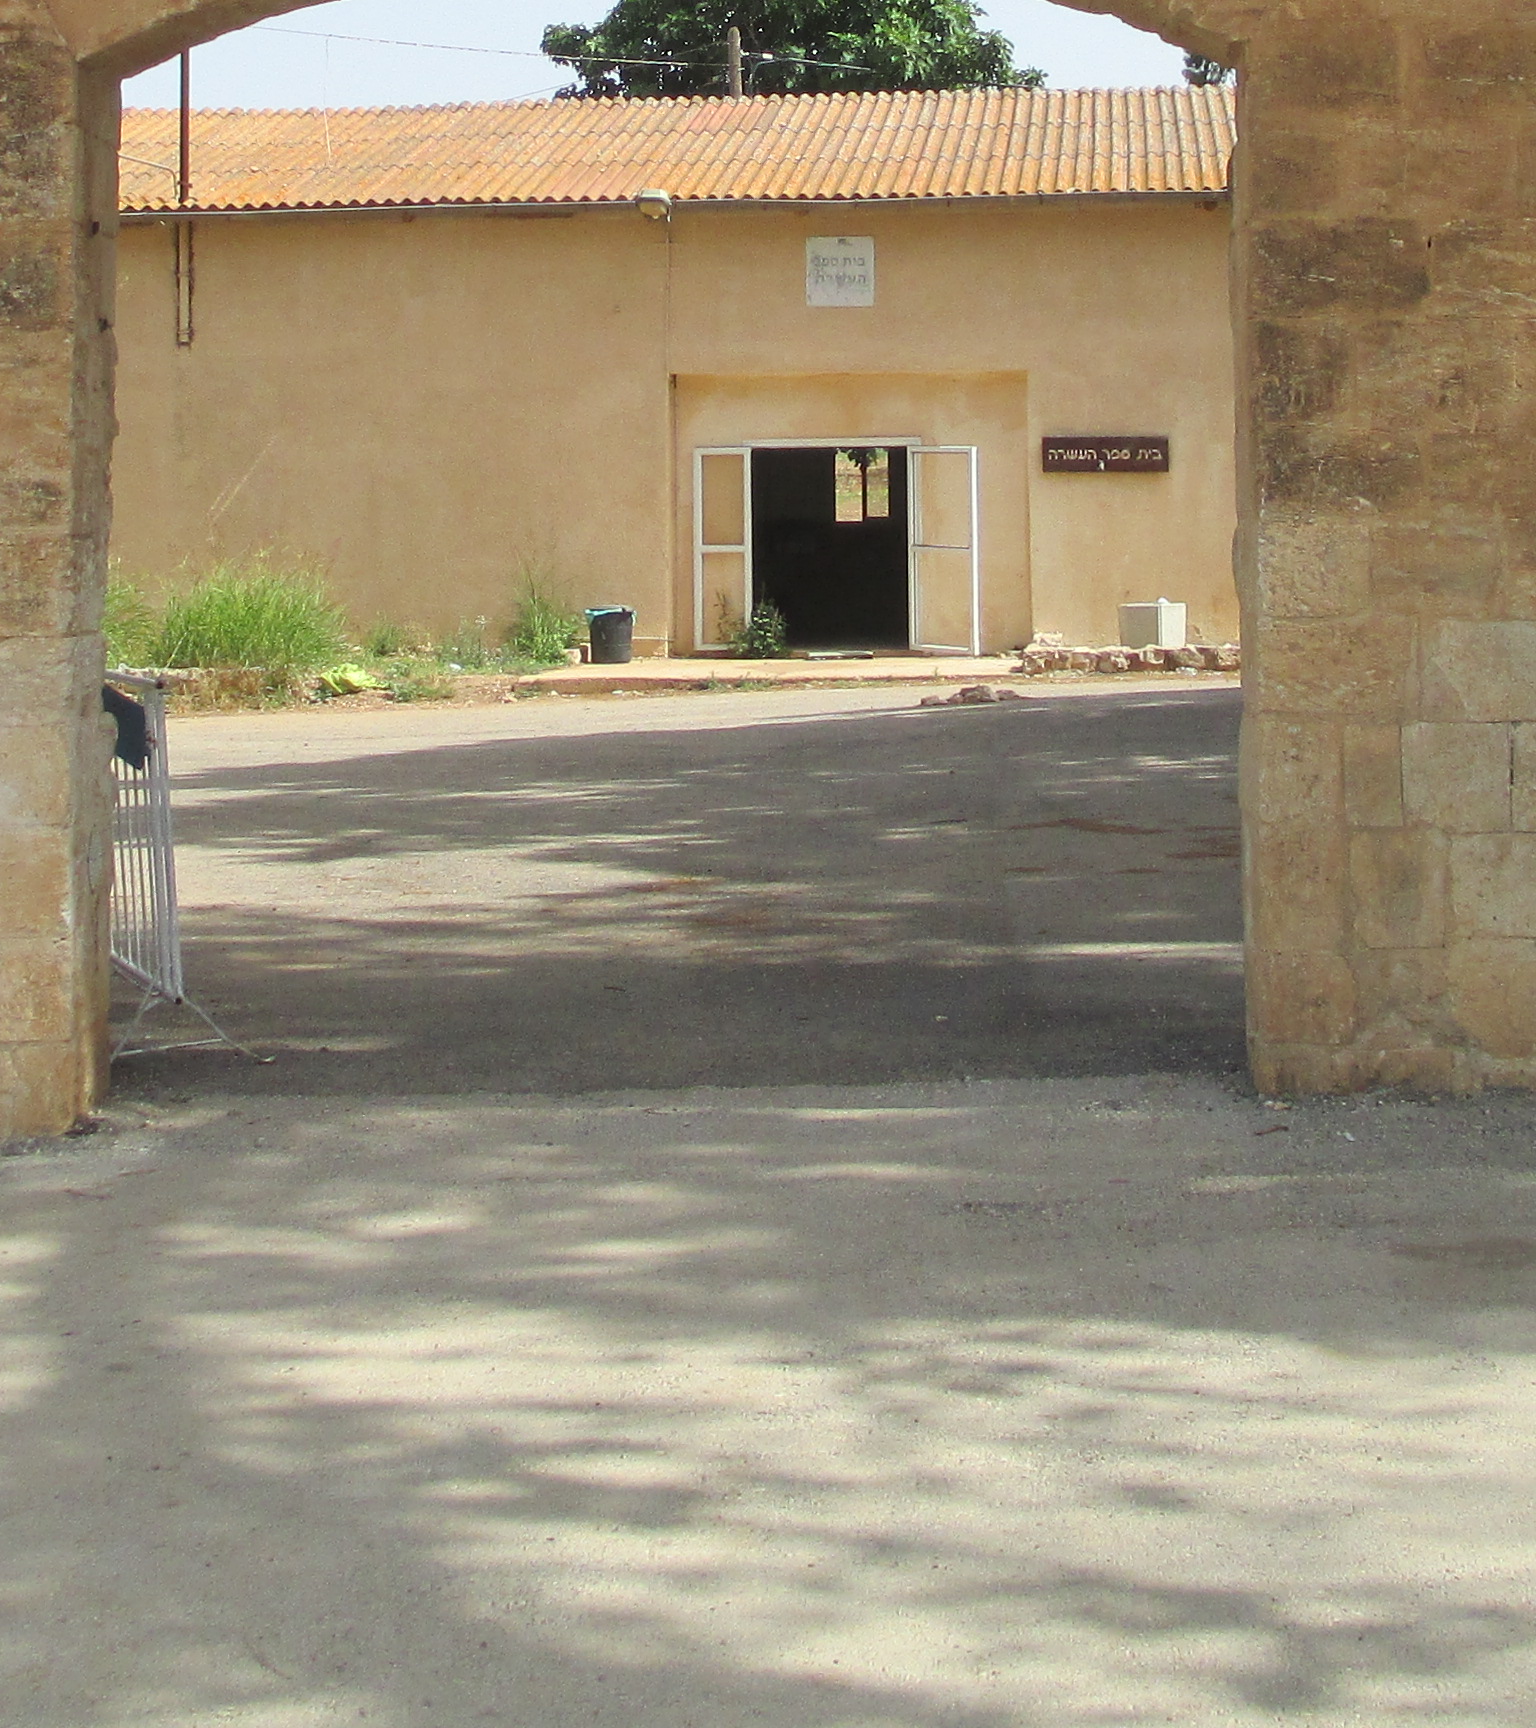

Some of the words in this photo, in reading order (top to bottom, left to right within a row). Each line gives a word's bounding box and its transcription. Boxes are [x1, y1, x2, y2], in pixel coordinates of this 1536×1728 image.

[843, 257, 865, 267] בית
[1048, 449, 1097, 460] העשרה
[1102, 449, 1131, 460] ספר
[1136, 449, 1163, 460] בית
